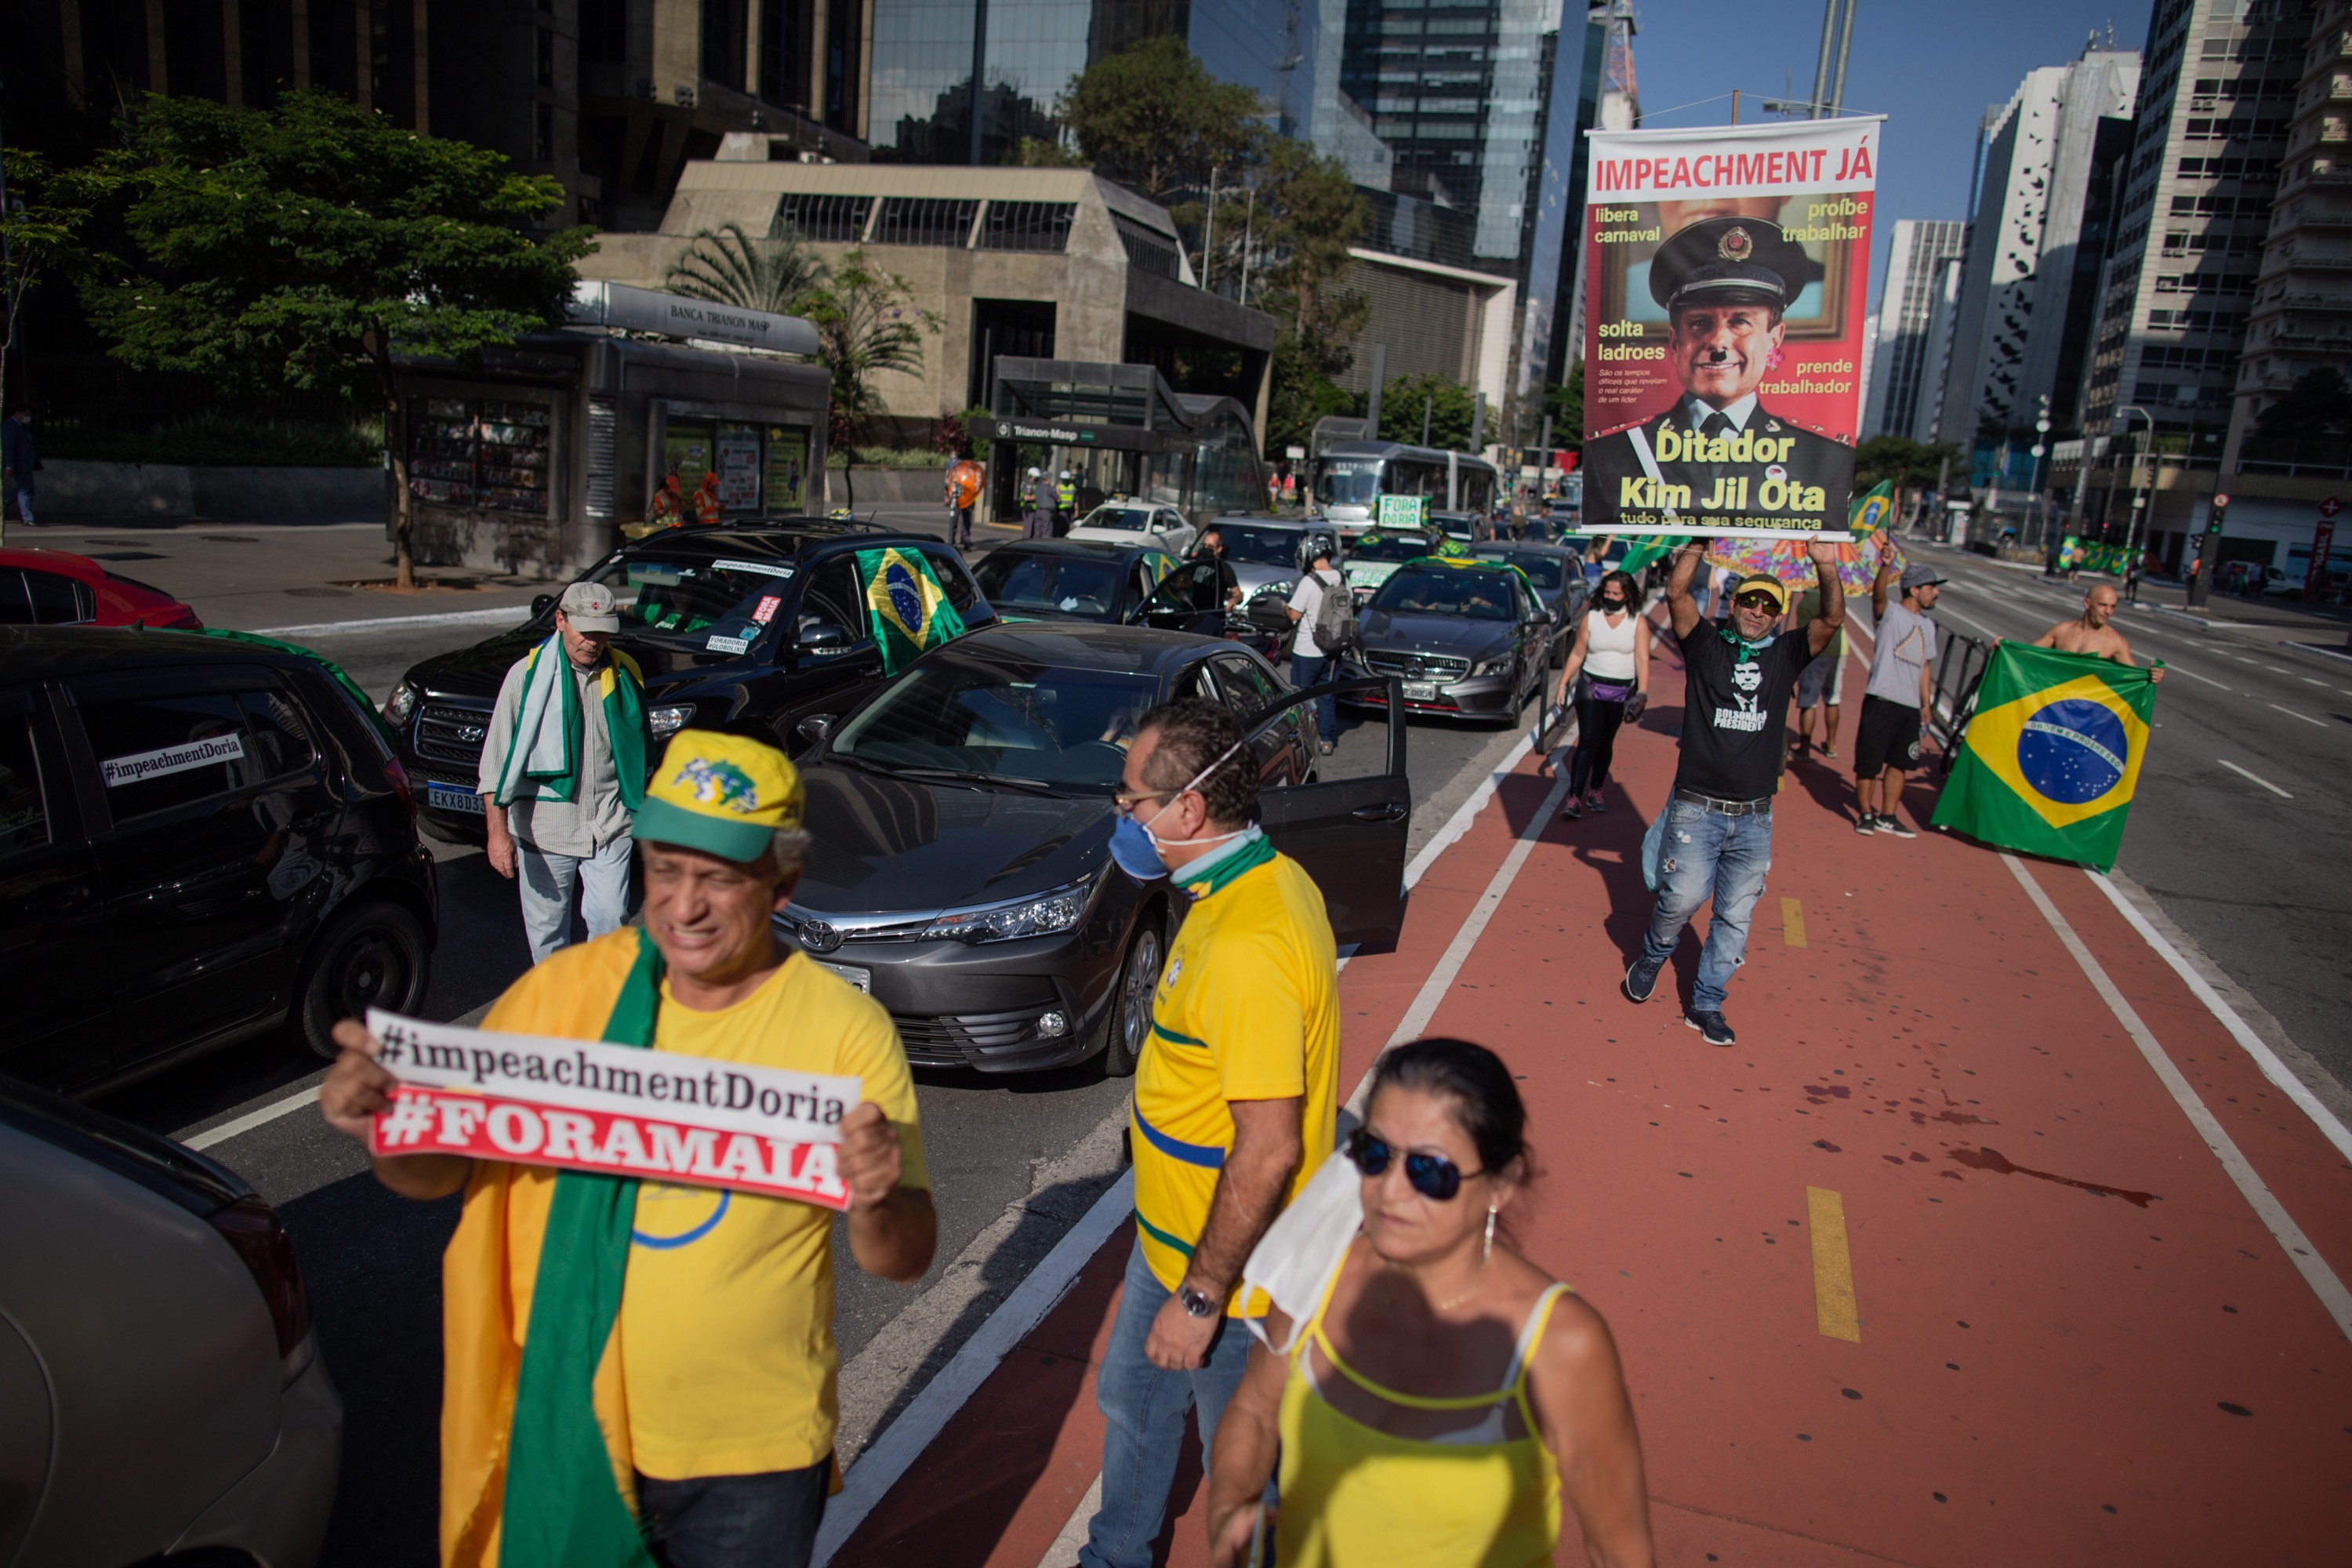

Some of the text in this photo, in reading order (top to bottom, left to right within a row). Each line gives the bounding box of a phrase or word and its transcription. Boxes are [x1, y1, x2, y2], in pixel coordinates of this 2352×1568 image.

[1595, 135, 1872, 191] IMPEACHMENT JÁ
[1595, 207, 1639, 223] libera
[1808, 198, 1868, 220] proíbe
[1595, 226, 1661, 243] carnaval
[1782, 222, 1867, 243] trabalhar
[671, 305, 771, 332] BANCA TRIANON MASP
[1598, 319, 1643, 338] solta
[1796, 359, 1853, 376] prende
[1759, 380, 1852, 394] trabalhador
[1014, 425, 1078, 441] Trianon-Masp
[1656, 428, 1795, 463] Ditador
[1620, 477, 1691, 510] Kim
[1700, 477, 1748, 510] Jil
[1385, 498, 1417, 511] FORA
[1382, 514, 1417, 525] DORIA
[1620, 512, 1657, 524] tudo
[1700, 517, 1730, 527] sua
[1734, 517, 1822, 530] segurança
[714, 560, 792, 577] #impeachmentDoria
[710, 637, 746, 647] FORADORIA
[2031, 722, 2063, 735] ORDEM
[2072, 733, 2121, 768] PROGRESSO
[105, 739, 240, 781] #impeachmentDoria
[378, 1023, 845, 1127] #impeachmentDoria
[379, 1094, 847, 1199] #FORAMAIA
